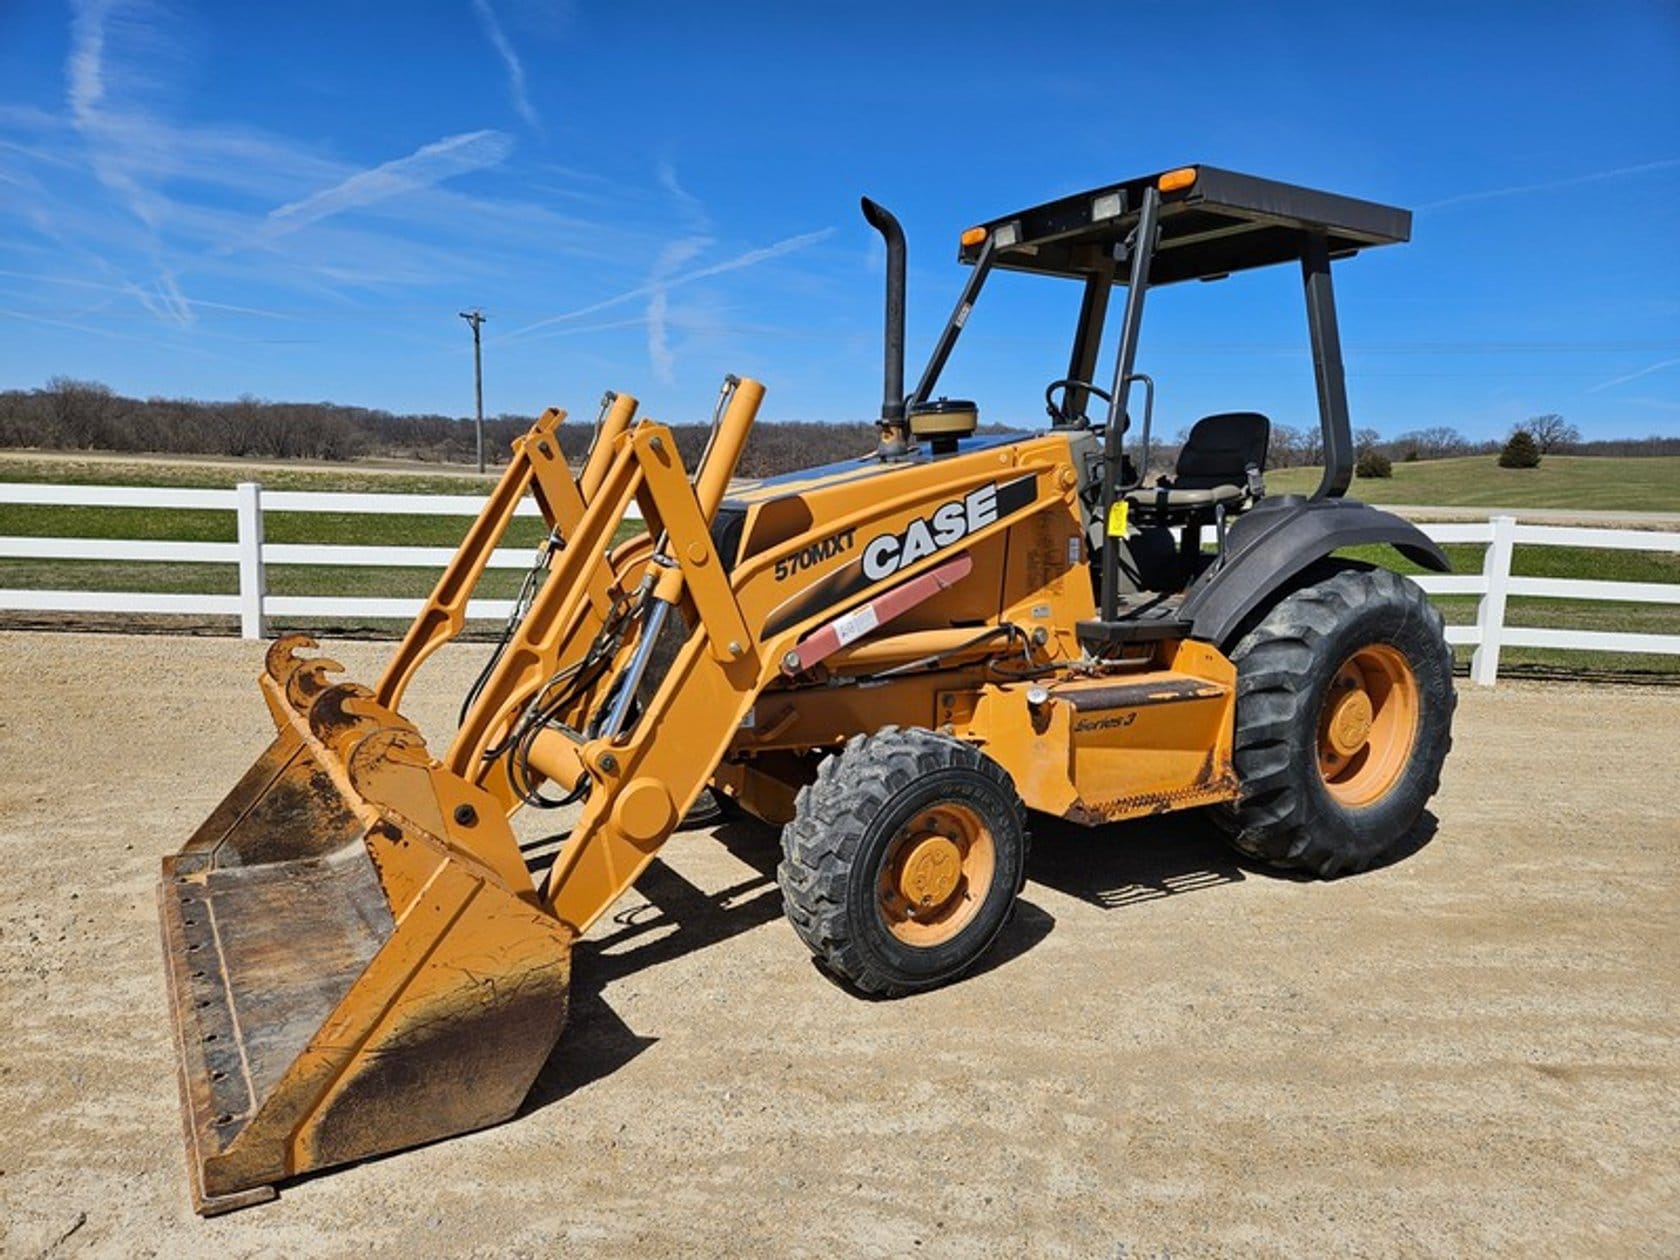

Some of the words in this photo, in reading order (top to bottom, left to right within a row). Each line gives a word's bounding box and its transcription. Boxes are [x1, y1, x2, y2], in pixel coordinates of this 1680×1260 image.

[774, 526, 857, 582] 570MXT
[862, 483, 998, 581] CASE
[1074, 716, 1124, 732] Series
